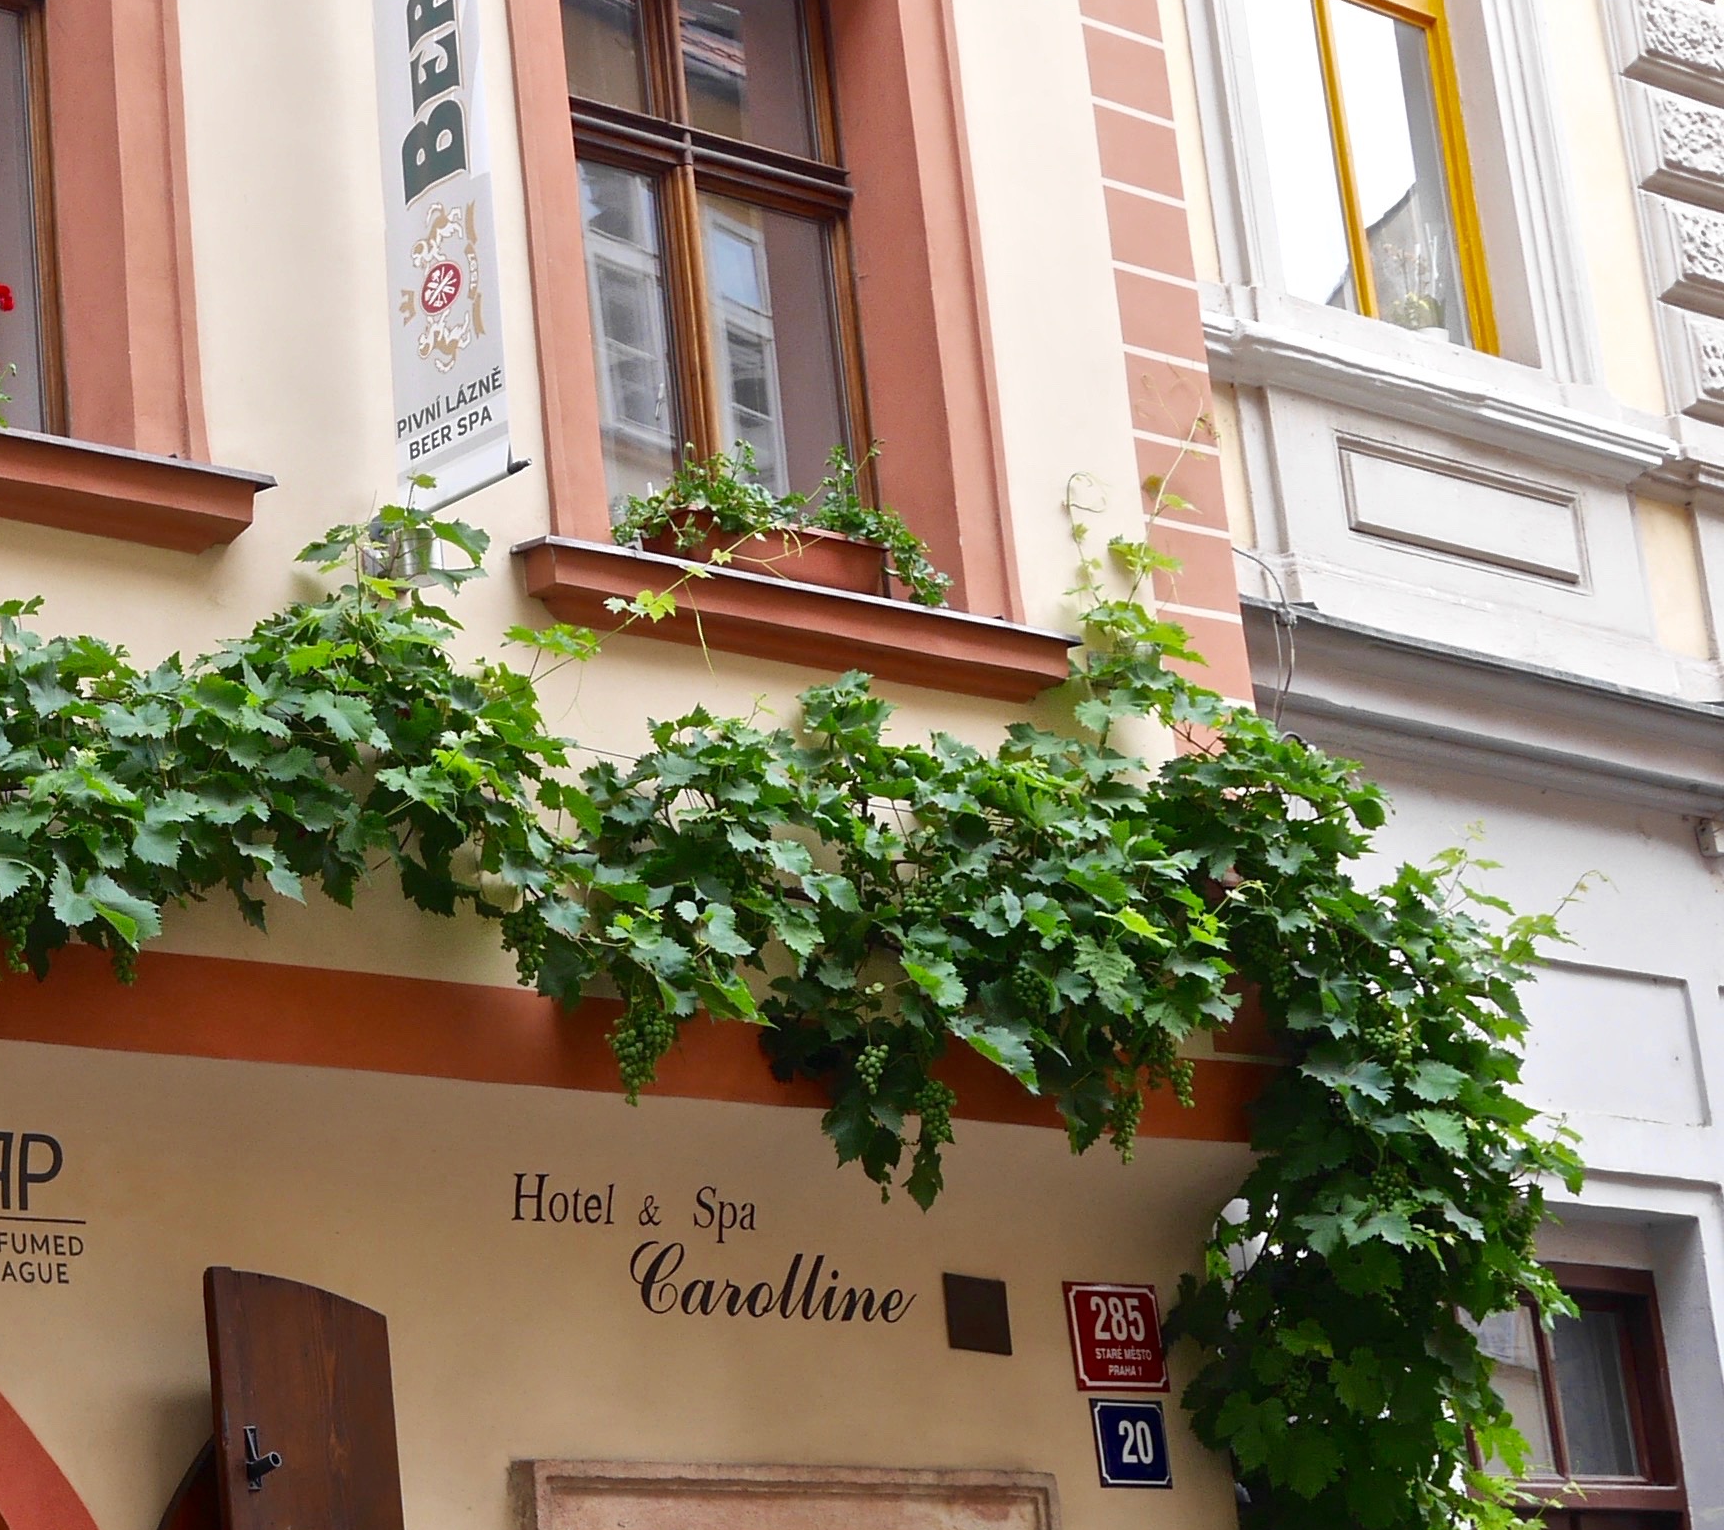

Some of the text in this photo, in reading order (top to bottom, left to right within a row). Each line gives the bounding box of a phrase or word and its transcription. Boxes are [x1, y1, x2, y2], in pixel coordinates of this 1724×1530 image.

[397, 366, 503, 439] PIVNÍ LÁZNĚ
[409, 406, 493, 461] BEER SPA
[511, 1173, 757, 1243] Hotel & Spa
[629, 1240, 917, 1324] Carolline
[1090, 1296, 1146, 1342] 285
[1095, 1345, 1152, 1360] STARÉ MĚSTO
[1108, 1365, 1136, 1376] PRAHA
[1118, 1420, 1154, 1464] 20
